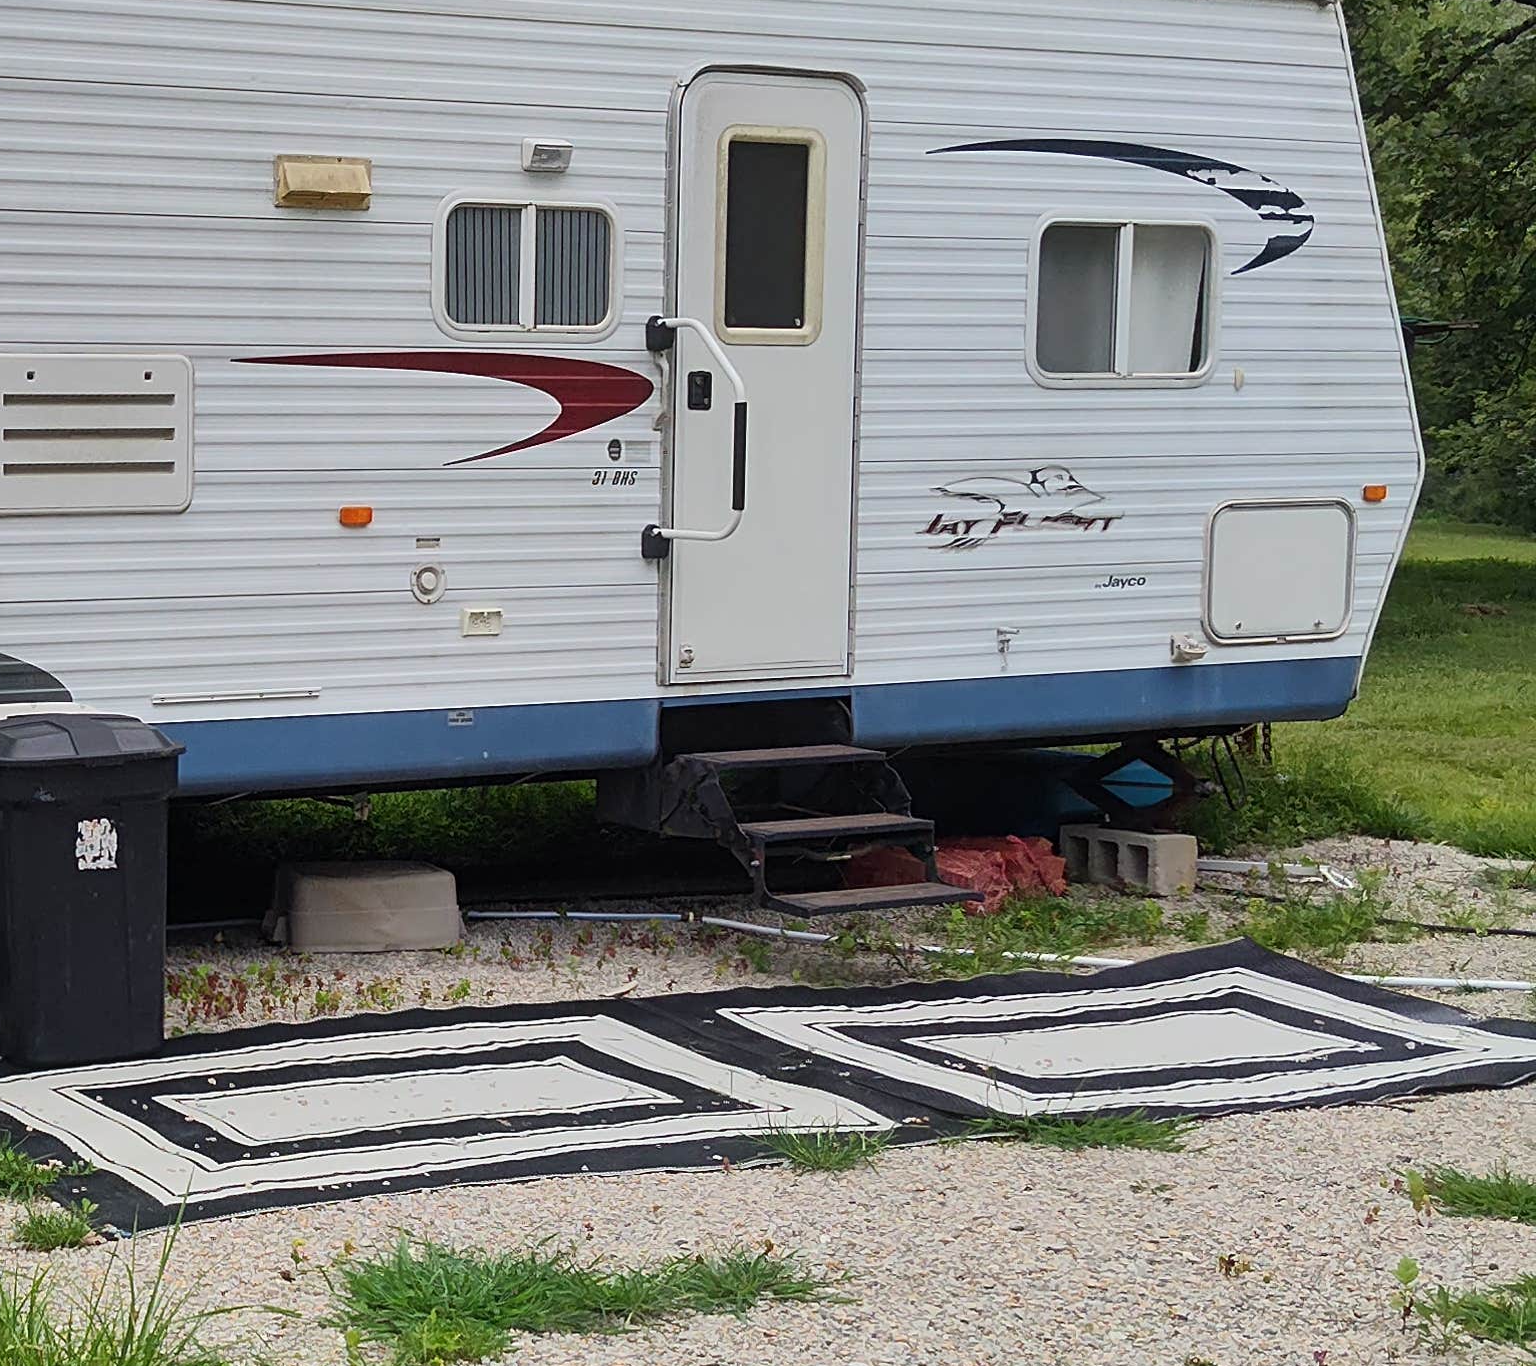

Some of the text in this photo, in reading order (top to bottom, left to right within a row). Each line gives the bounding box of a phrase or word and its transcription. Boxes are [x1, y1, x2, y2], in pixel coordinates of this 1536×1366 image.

[591, 470, 639, 486] 31 BHS
[916, 513, 986, 535] JAY
[1102, 574, 1146, 590] Jayco
